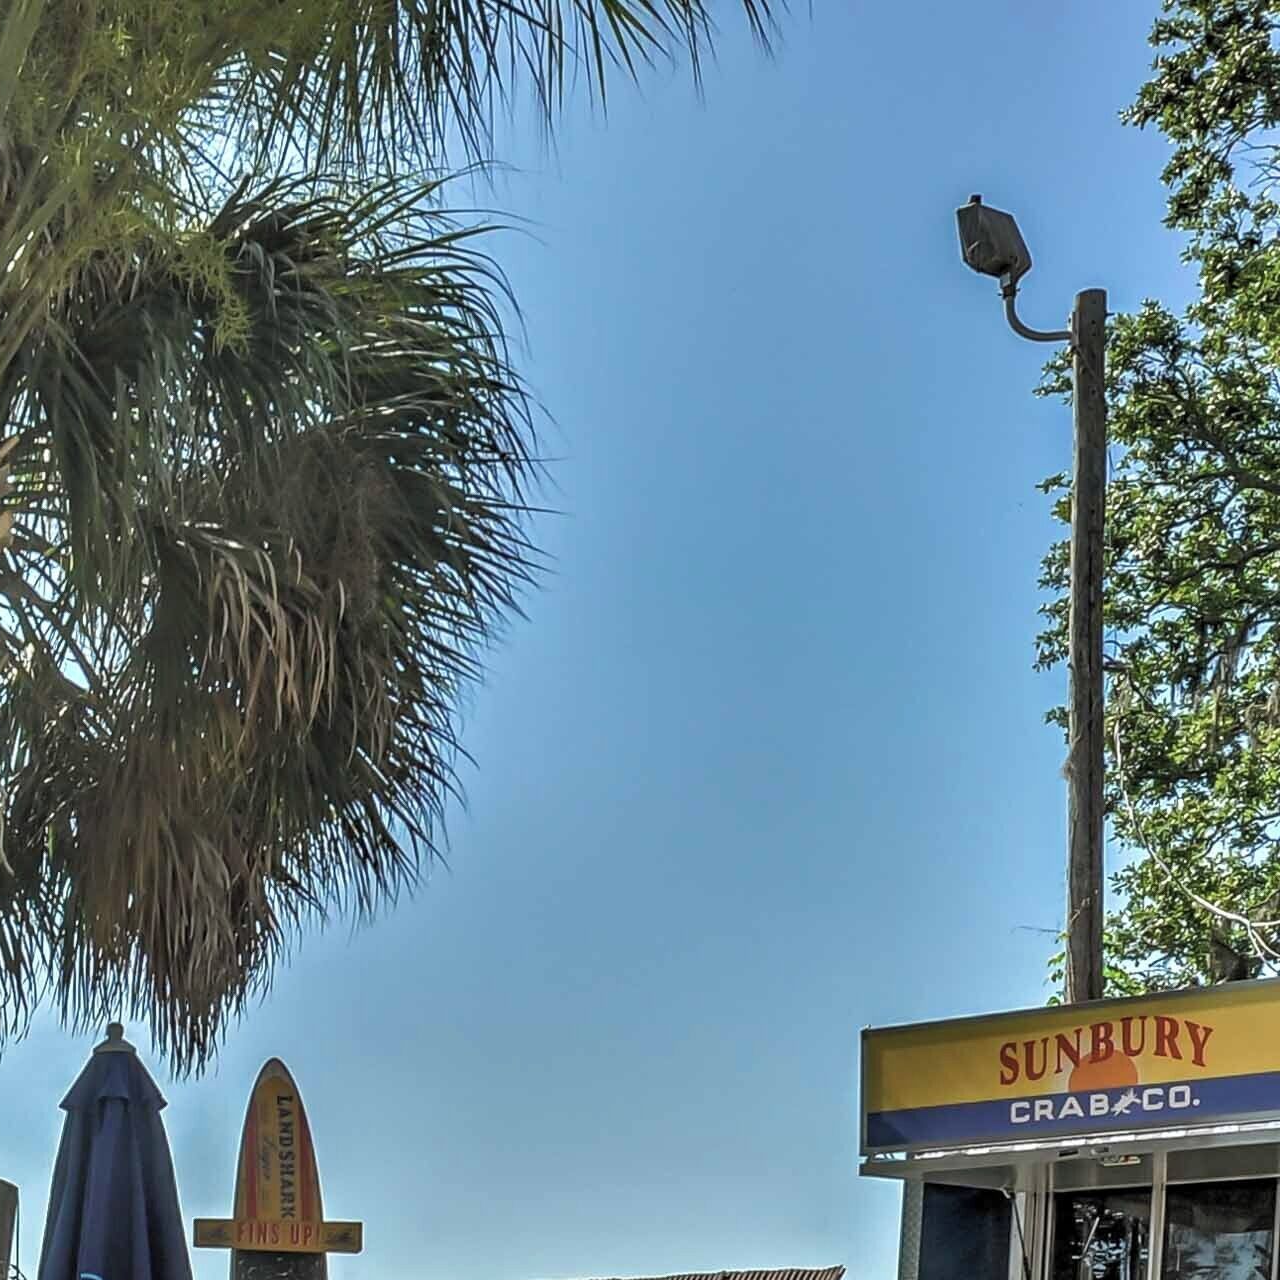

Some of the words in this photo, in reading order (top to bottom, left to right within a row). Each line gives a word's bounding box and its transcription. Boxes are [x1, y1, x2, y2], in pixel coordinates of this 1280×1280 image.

[999, 1015, 1214, 1085] SUNBURY
[1010, 1093, 1108, 1124] CRAB
[1142, 1084, 1202, 1113] CO.
[276, 1095, 295, 1218] LANDSHARK
[237, 1223, 281, 1245] FINS
